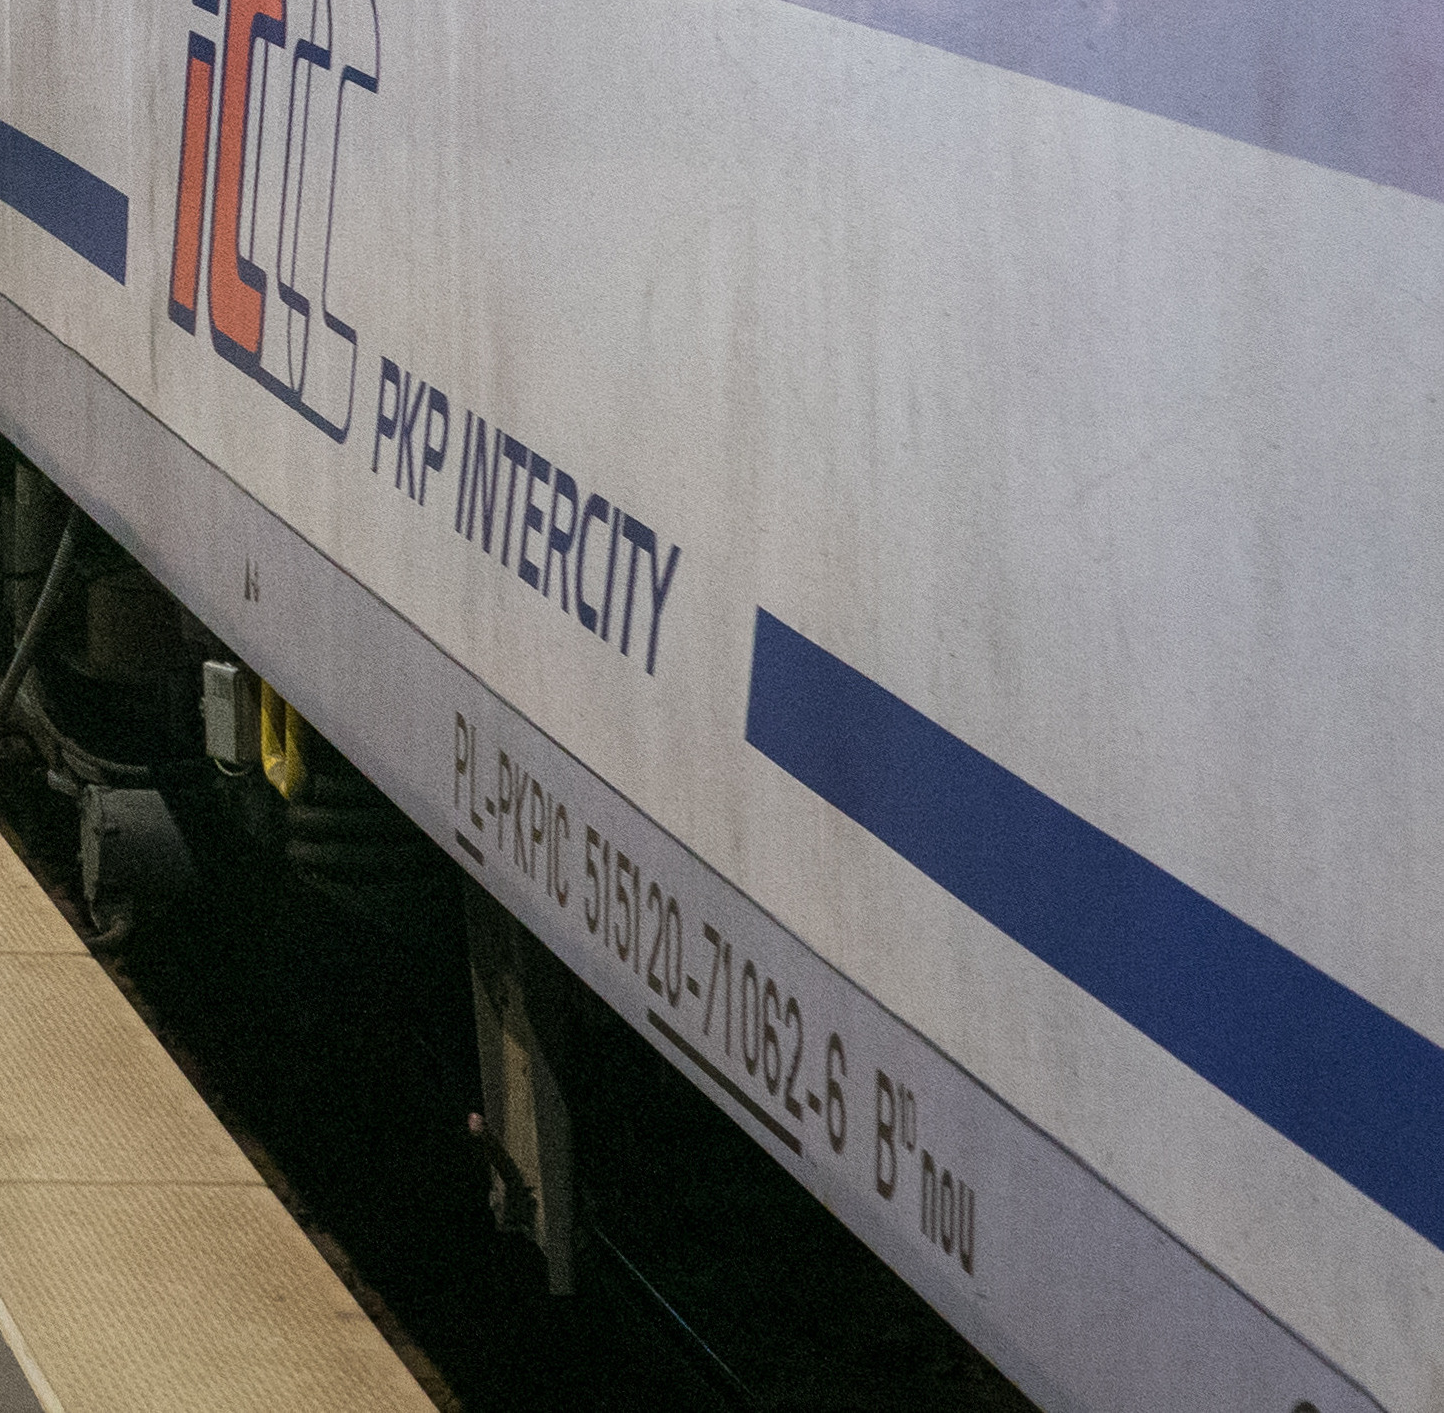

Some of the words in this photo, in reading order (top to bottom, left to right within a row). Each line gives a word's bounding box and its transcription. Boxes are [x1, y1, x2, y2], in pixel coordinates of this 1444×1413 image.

[370, 355, 449, 507] PKP
[454, 409, 683, 677] INTERCITY
[454, 710, 569, 908] PL-PKPIC
